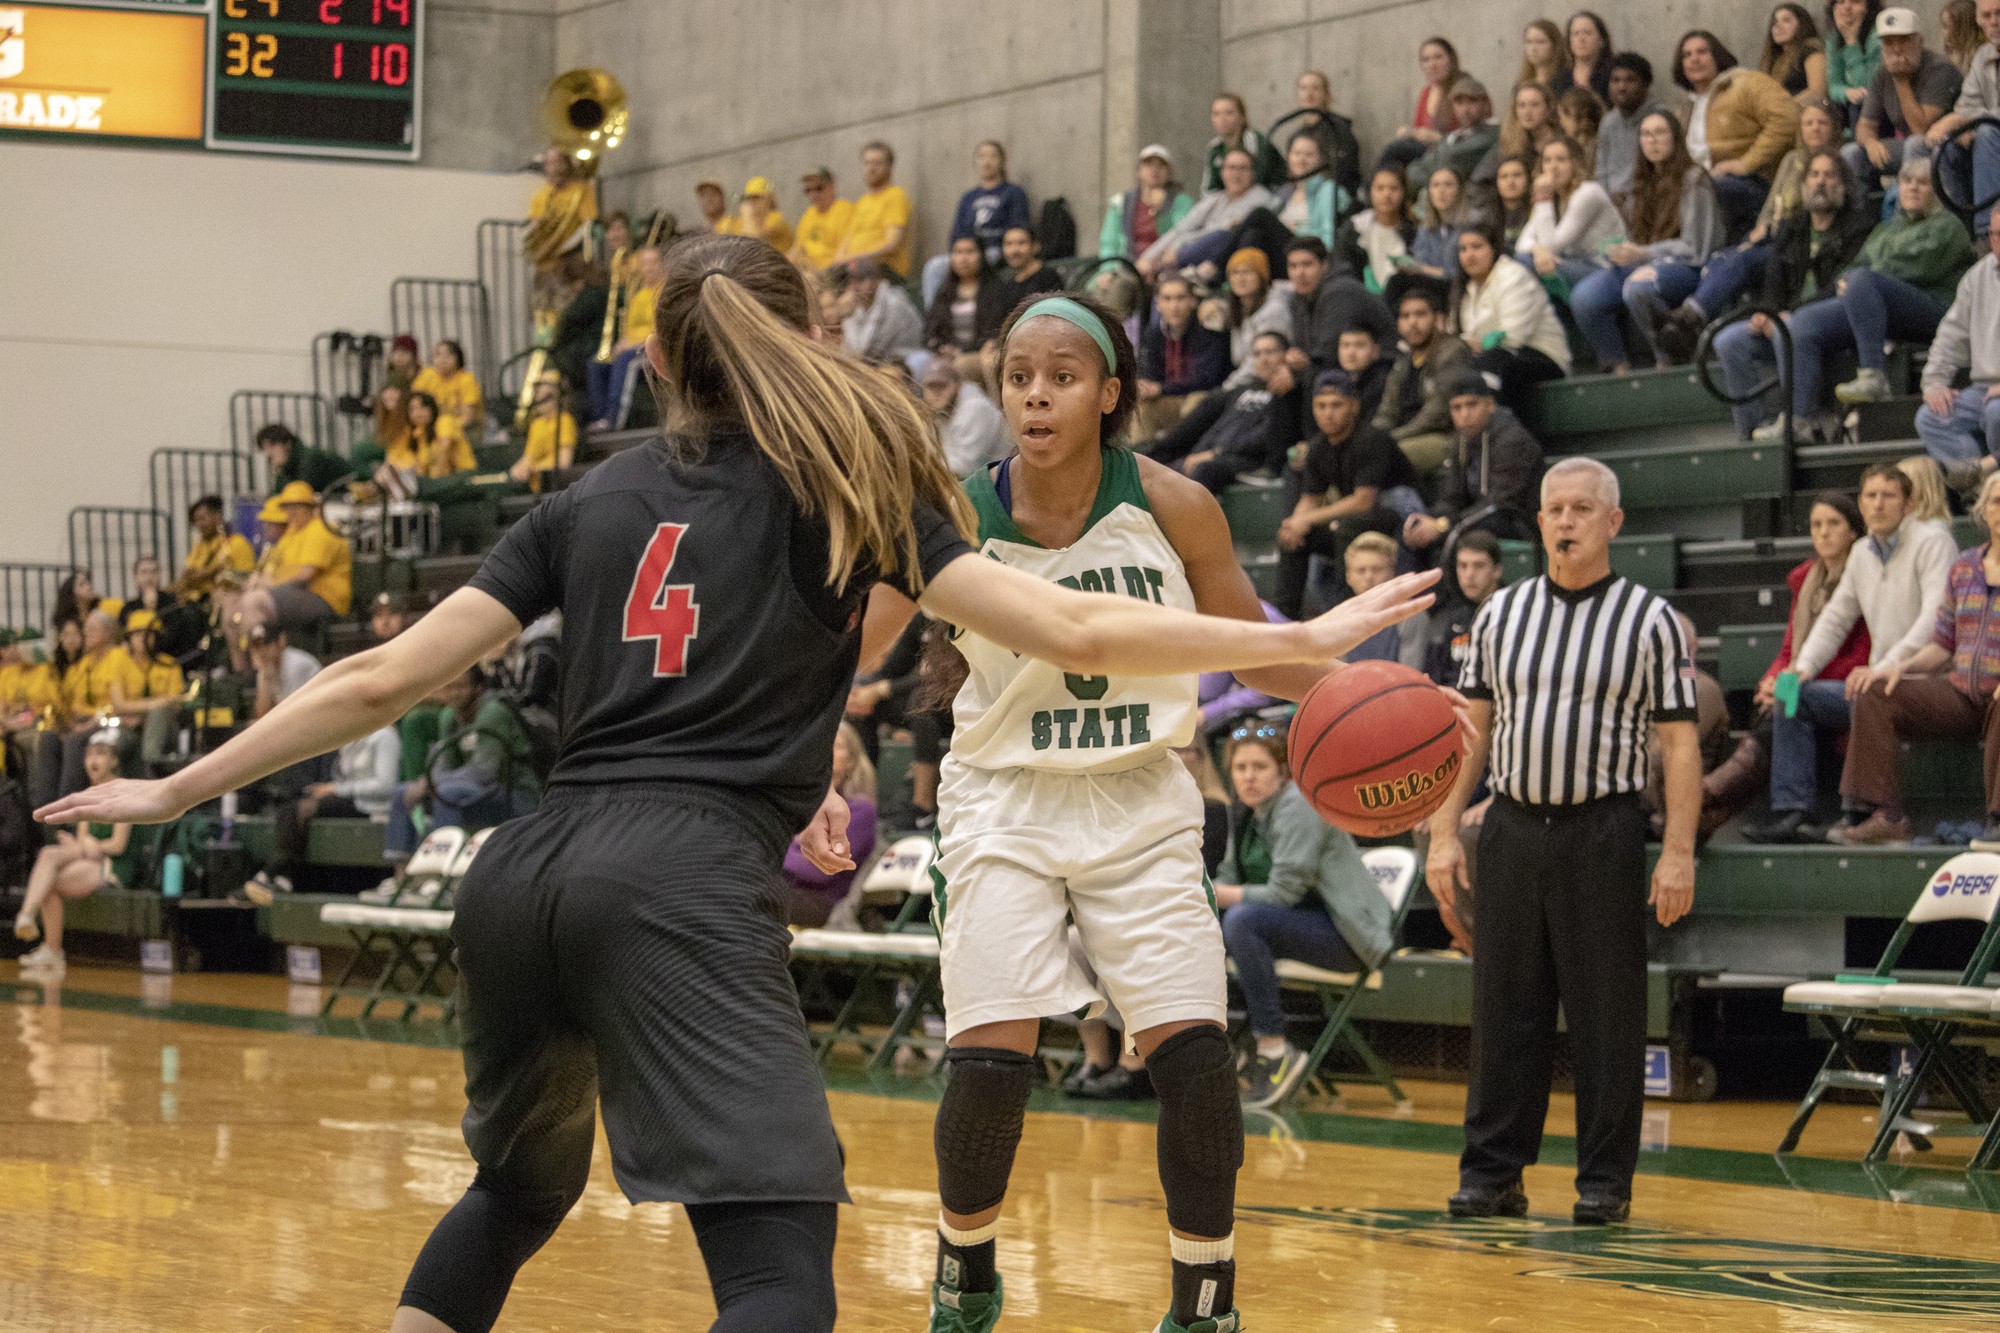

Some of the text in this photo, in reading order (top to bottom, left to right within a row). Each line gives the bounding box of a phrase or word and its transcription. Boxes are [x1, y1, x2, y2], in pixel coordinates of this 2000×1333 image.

[226, 32, 410, 86] 32 1 10
[622, 522, 700, 678] 4
[1031, 703, 1151, 751] STATE
[1354, 749, 1459, 812] Wilson
[1950, 873, 1999, 897] PEPSI
